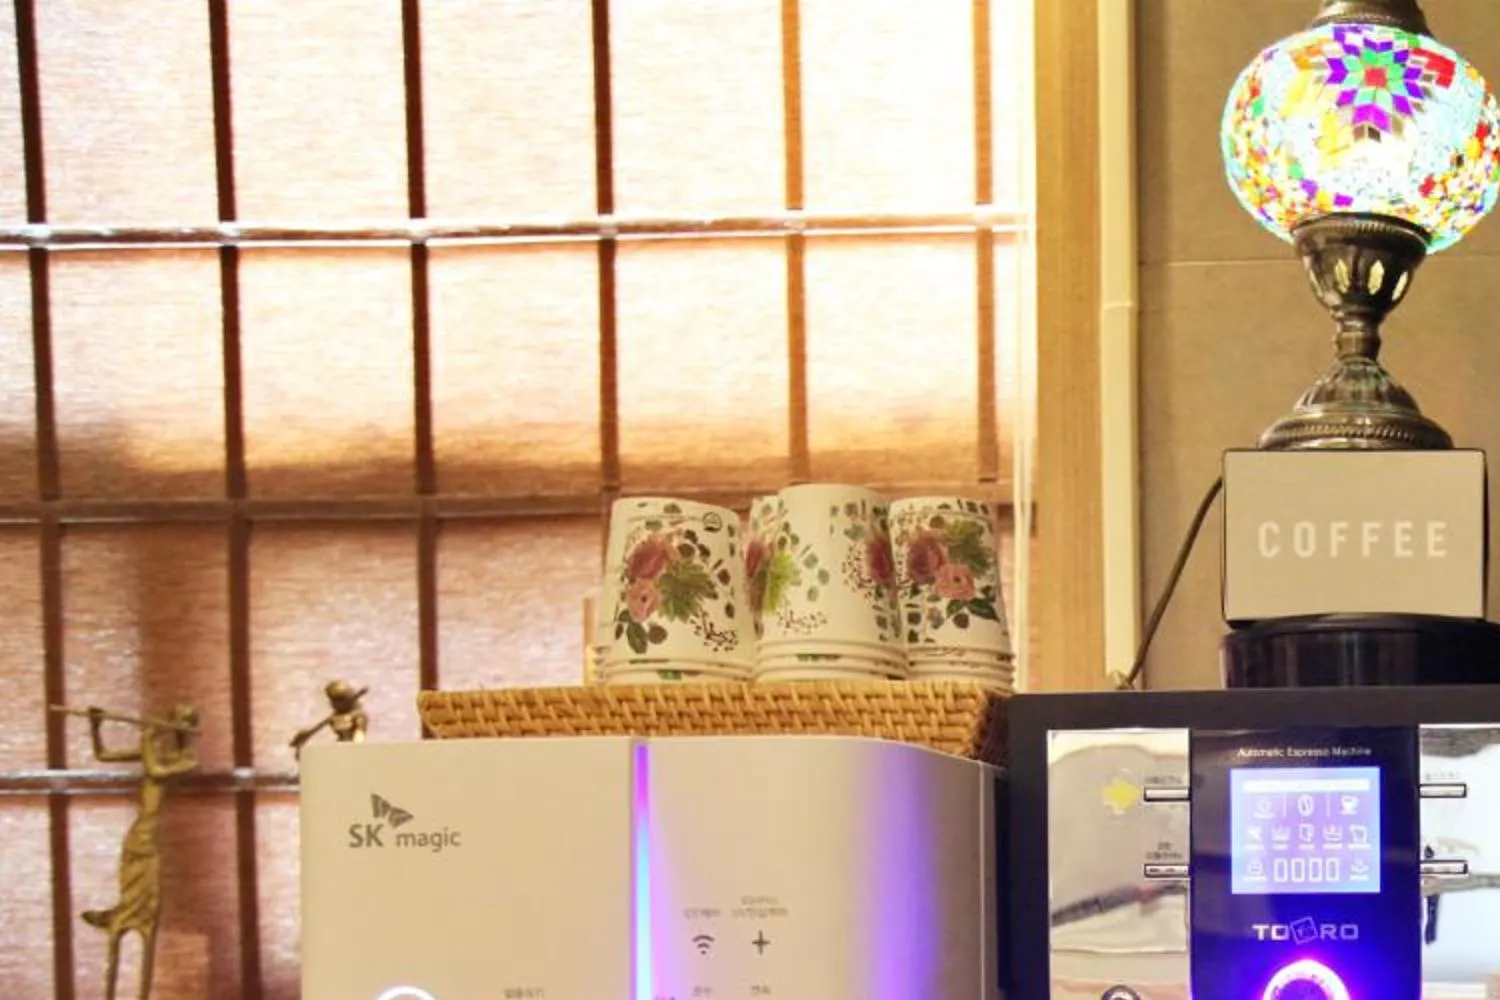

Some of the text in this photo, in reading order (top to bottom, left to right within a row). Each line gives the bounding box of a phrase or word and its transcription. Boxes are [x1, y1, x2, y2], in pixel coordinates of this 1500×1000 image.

[1258, 520, 1449, 559] COFFEE
[348, 822, 463, 853] SK magic
